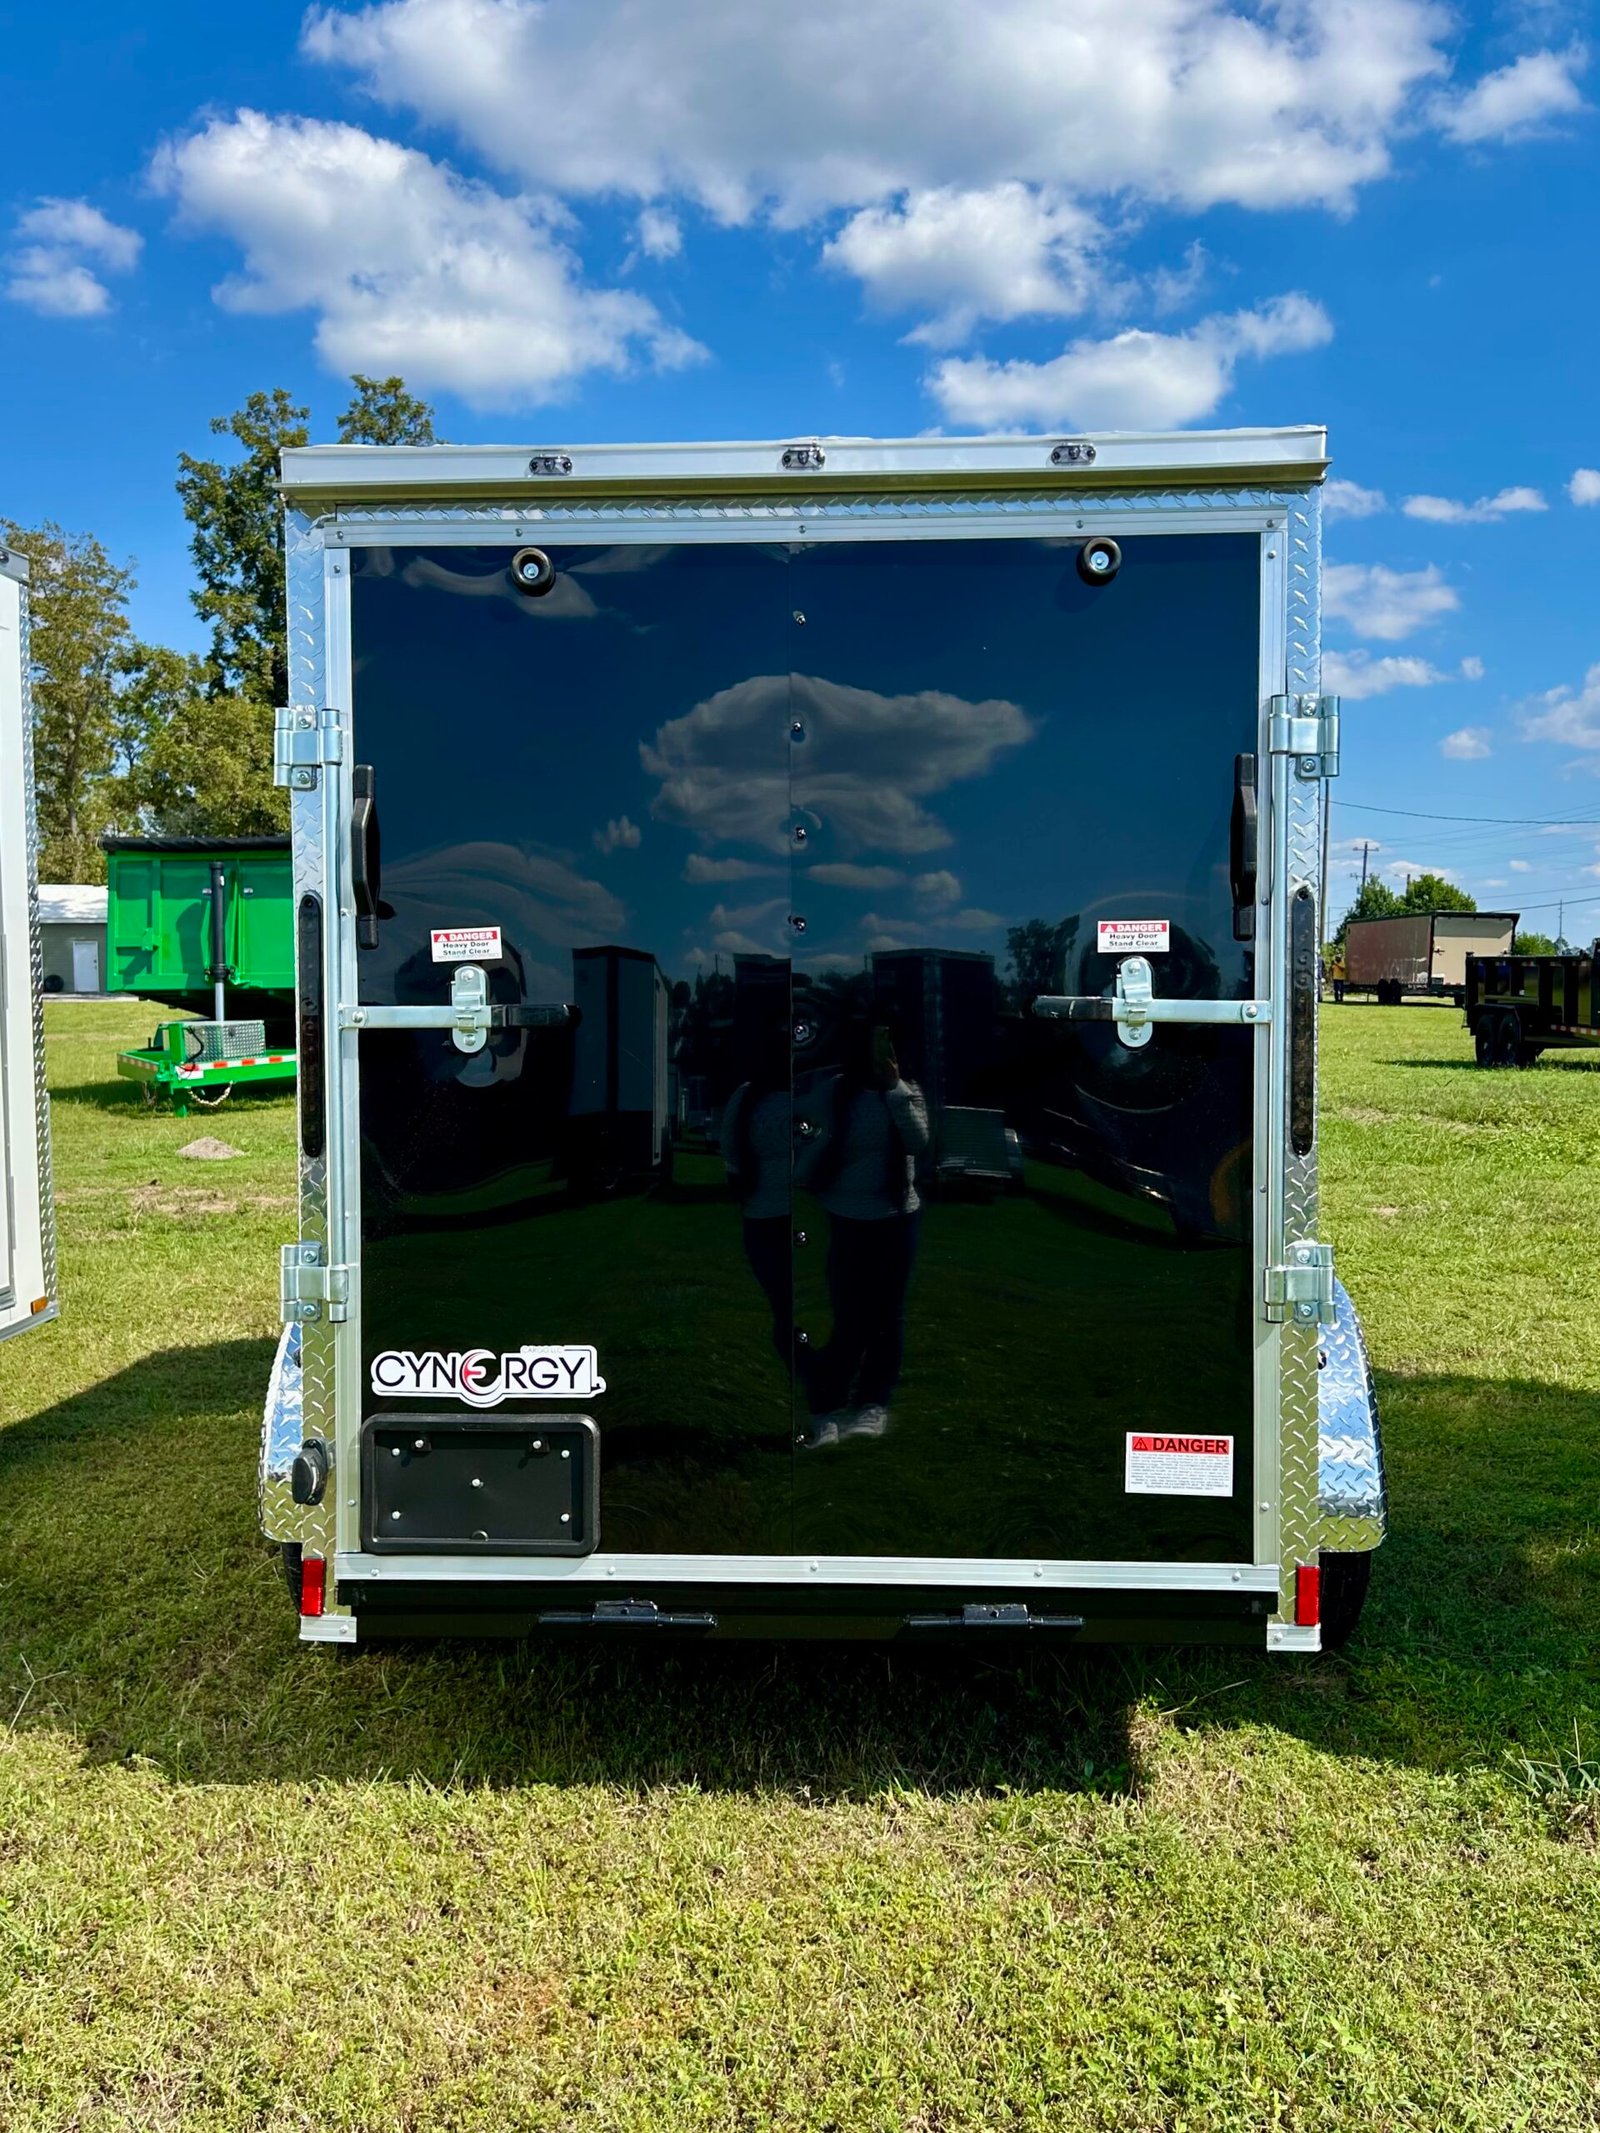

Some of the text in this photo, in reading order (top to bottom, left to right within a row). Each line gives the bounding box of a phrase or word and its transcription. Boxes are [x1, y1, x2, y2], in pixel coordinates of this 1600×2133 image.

[1116, 924, 1162, 932] DANGER
[449, 932, 493, 941] DANGER
[375, 1351, 586, 1395] CYNERGY
[1152, 1437, 1228, 1454] DANGER
